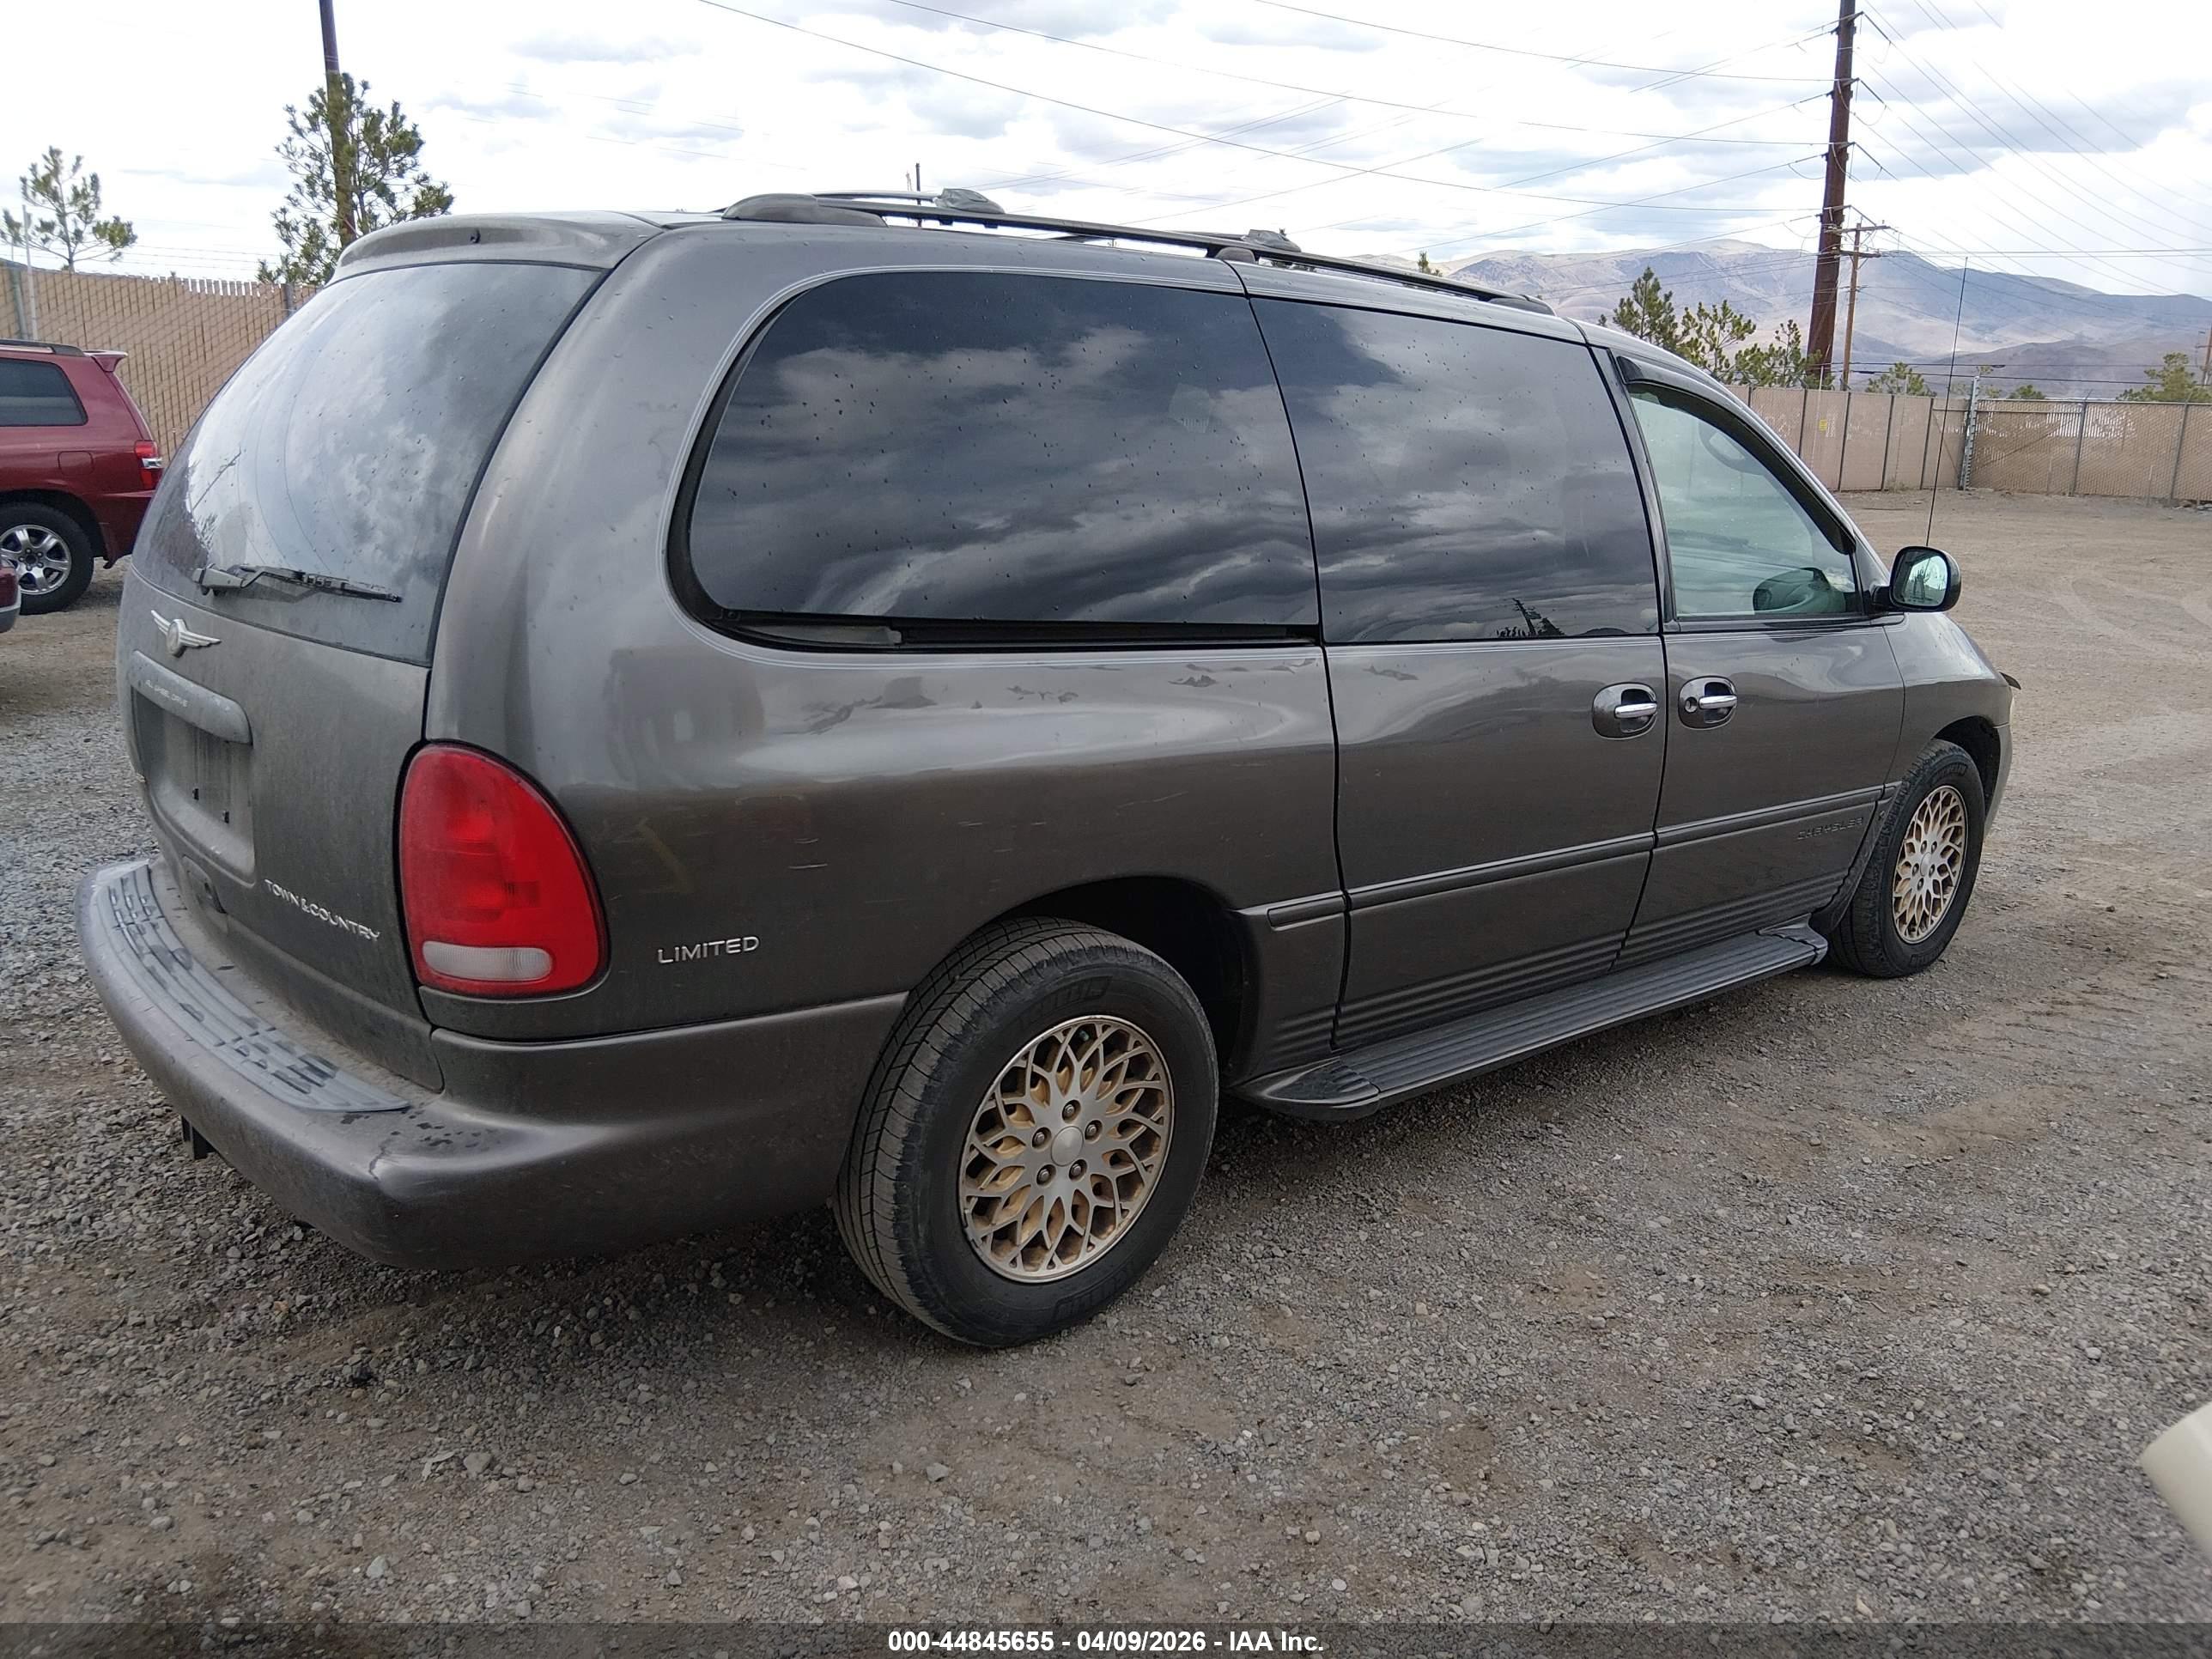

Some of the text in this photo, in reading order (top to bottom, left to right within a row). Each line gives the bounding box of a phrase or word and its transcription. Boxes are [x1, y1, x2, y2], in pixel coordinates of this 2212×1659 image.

[264, 878, 300, 907] TOWN
[309, 903, 380, 942] COUNTRY
[657, 936, 760, 963] LIMITED
